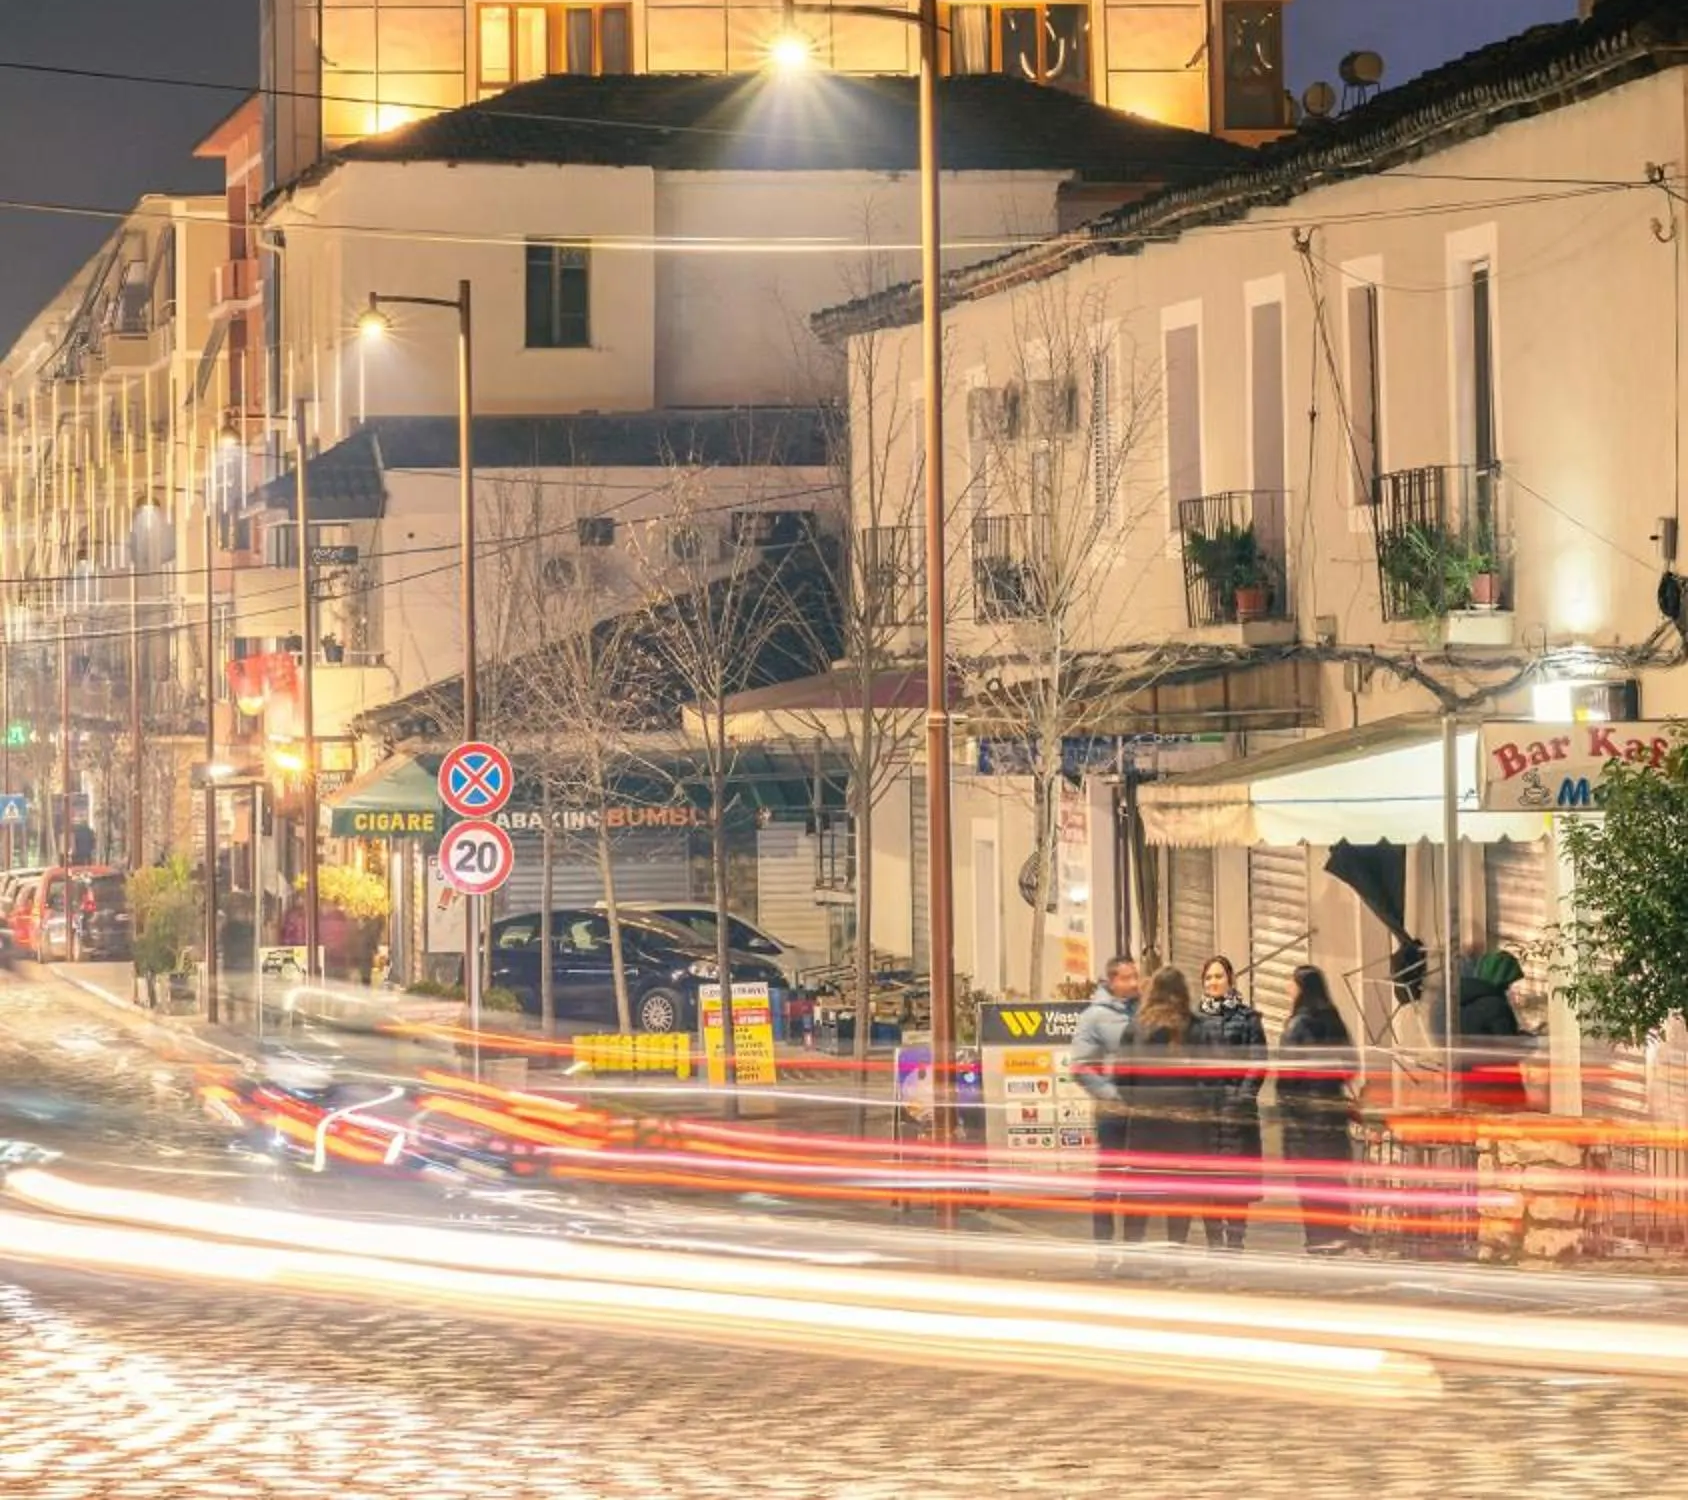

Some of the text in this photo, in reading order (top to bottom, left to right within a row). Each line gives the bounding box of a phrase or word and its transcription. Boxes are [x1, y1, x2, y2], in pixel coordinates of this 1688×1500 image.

[1493, 725, 1670, 781] Bar Kaf
[354, 813, 435, 831] CIGARE
[455, 840, 498, 873] 20
[1045, 1011, 1080, 1023] West
[1045, 1024, 1077, 1036] Unio
